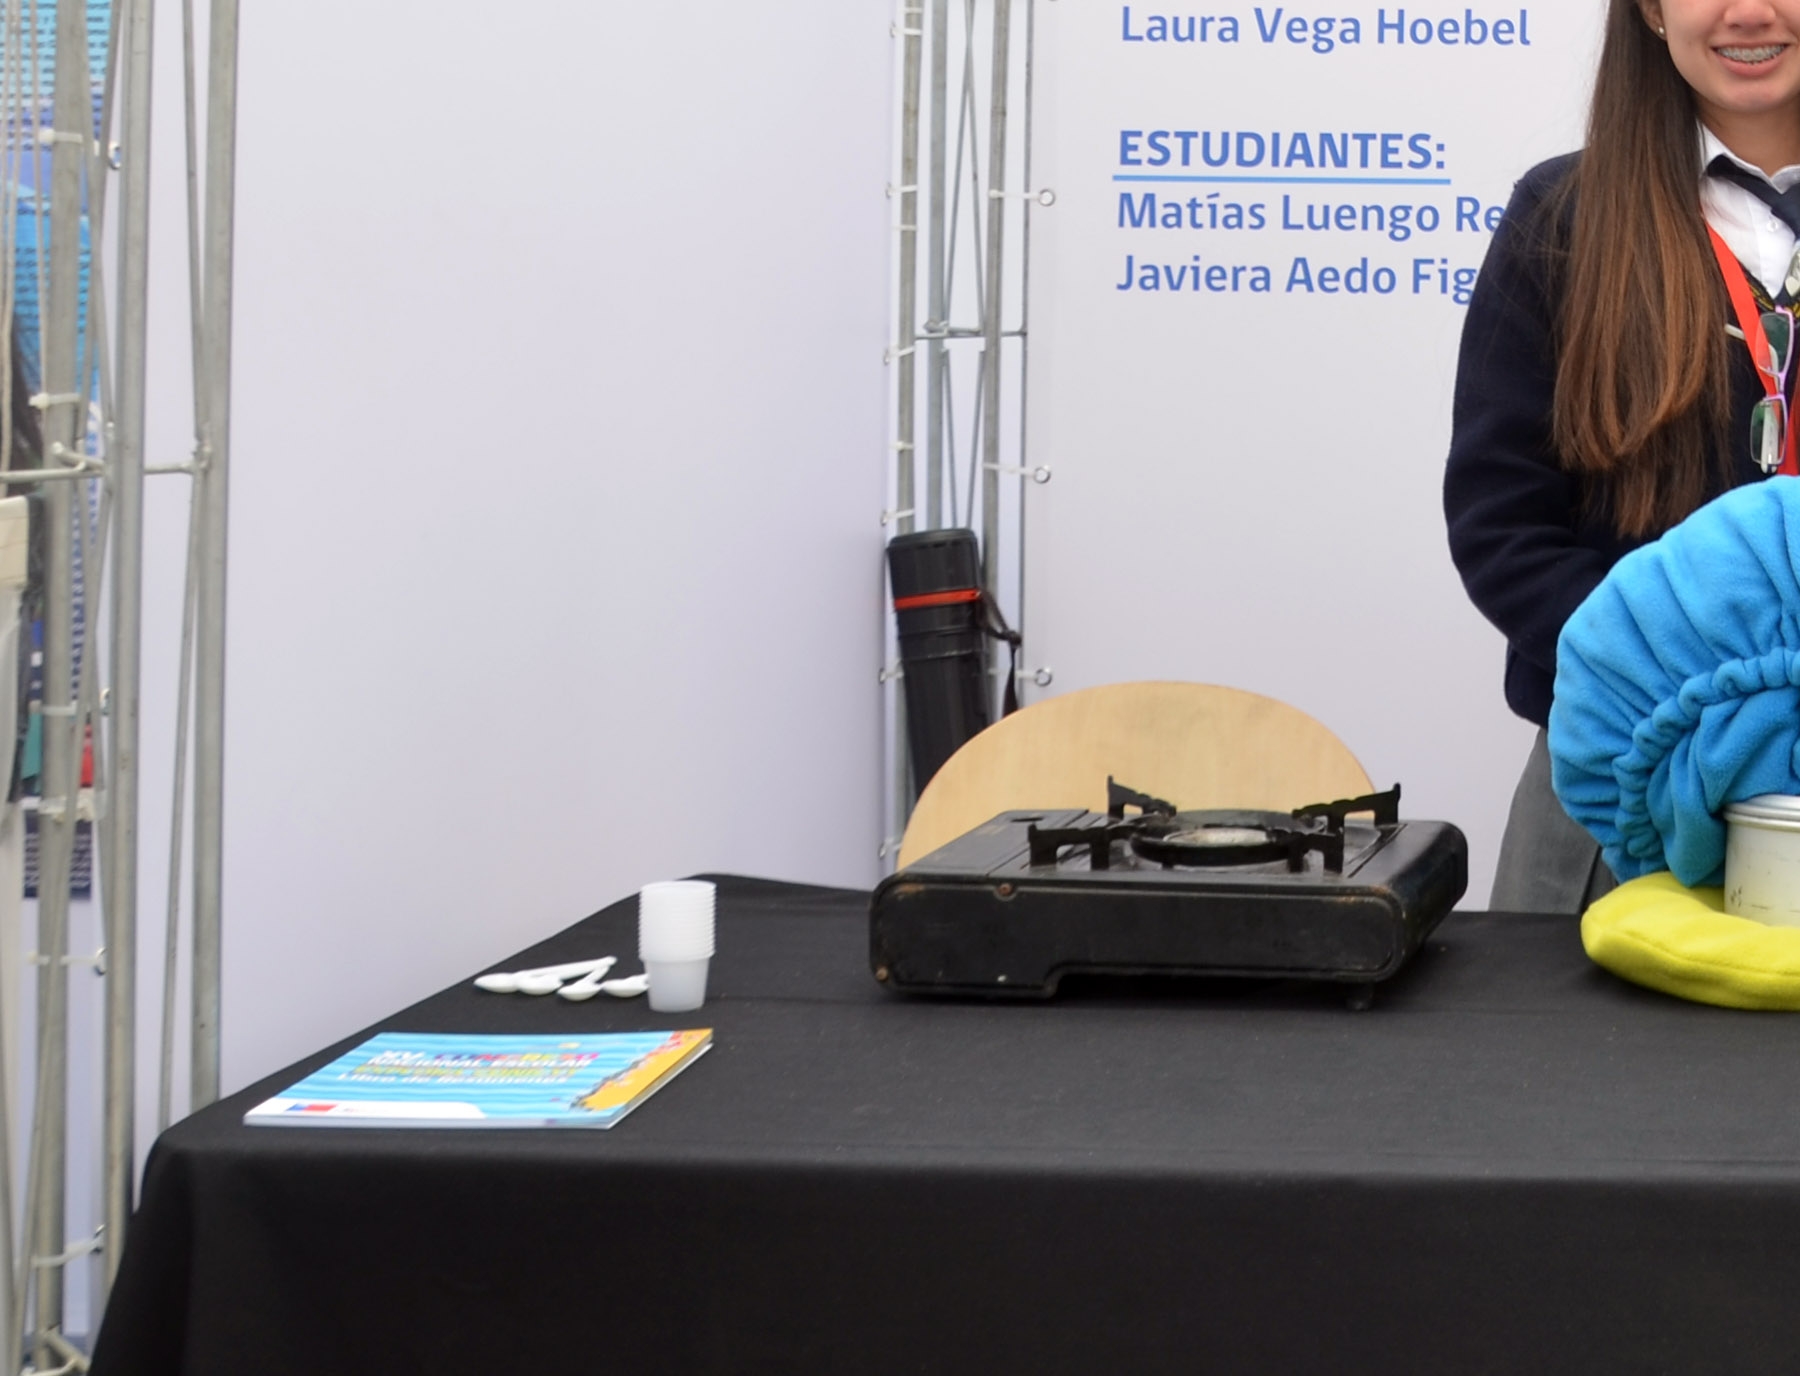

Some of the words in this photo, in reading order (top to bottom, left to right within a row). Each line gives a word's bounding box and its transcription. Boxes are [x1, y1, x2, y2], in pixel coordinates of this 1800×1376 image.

[1122, 6, 1240, 43] Laura
[1253, 8, 1361, 54] Vega
[1377, 9, 1531, 46] Hoebel
[1118, 130, 1447, 170] ESTUDIANTES:
[1116, 192, 1267, 230] Matías
[1281, 195, 1441, 243] Luengo
[1456, 196, 1505, 233] Re
[1116, 254, 1272, 293] Javiera
[1286, 257, 1397, 295] Aedo
[1412, 256, 1477, 306] Fig
